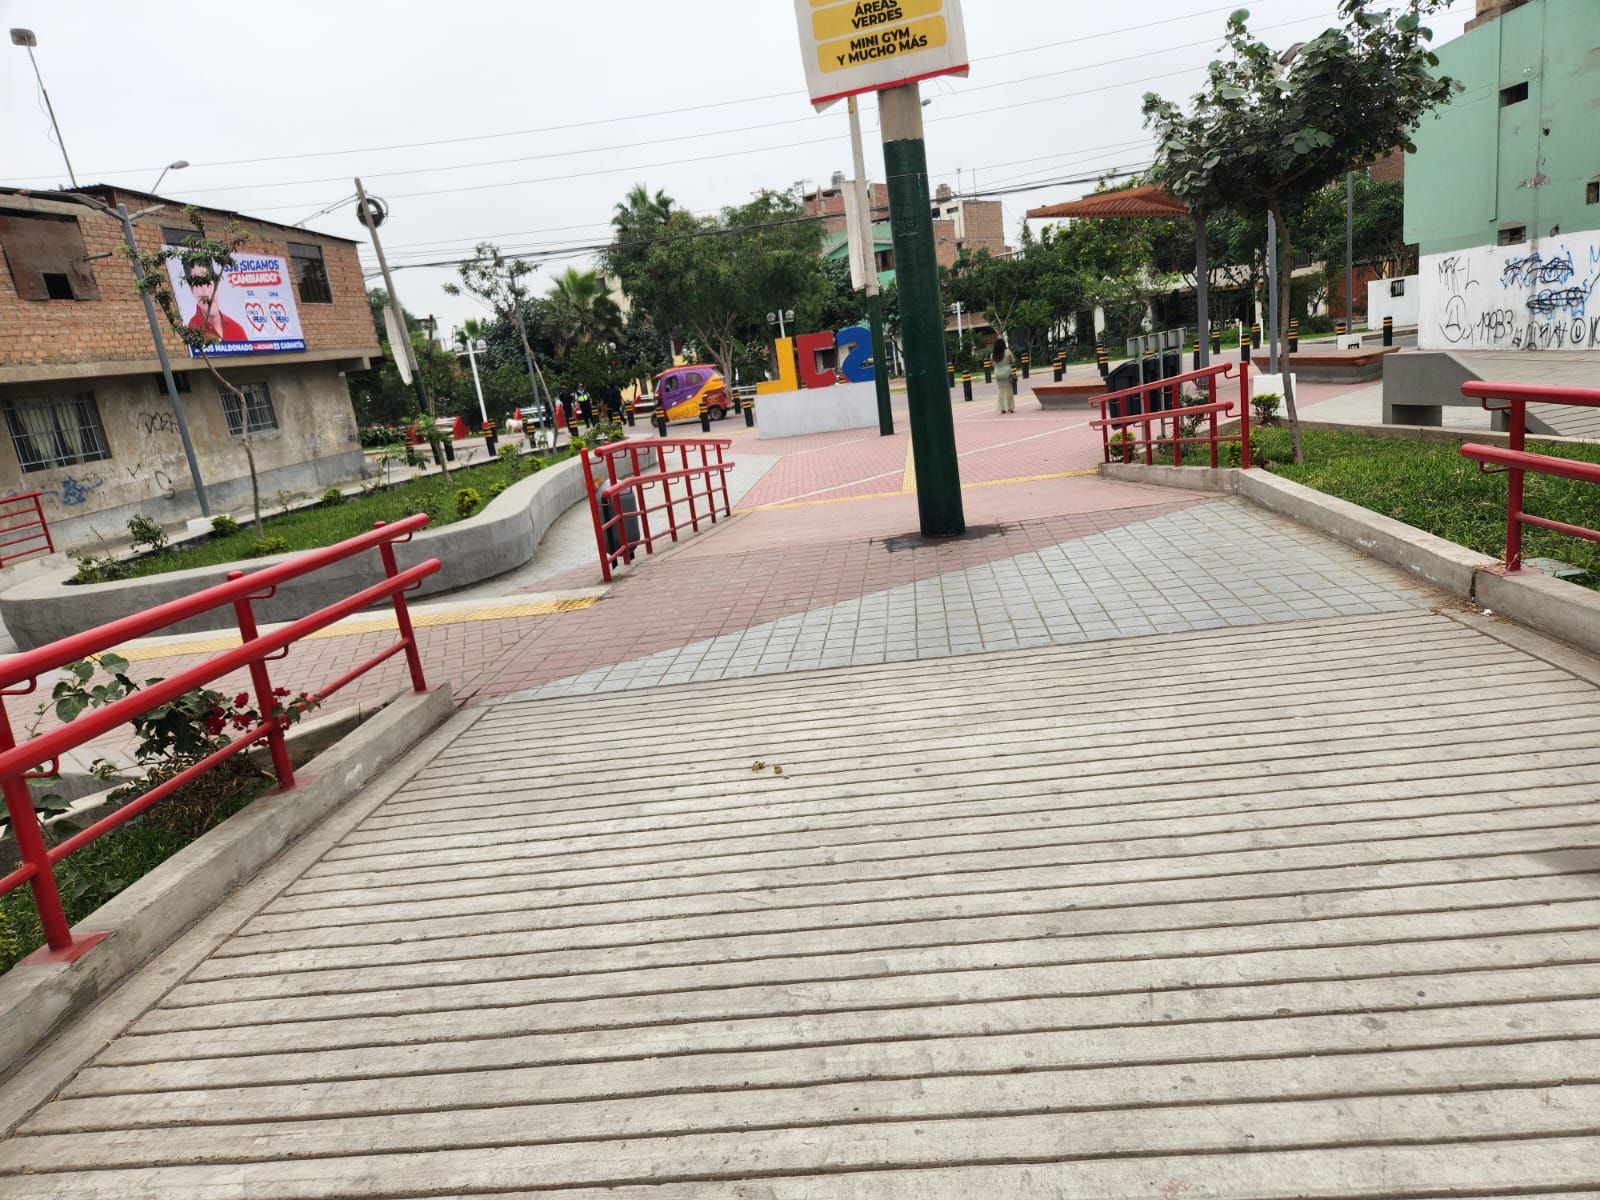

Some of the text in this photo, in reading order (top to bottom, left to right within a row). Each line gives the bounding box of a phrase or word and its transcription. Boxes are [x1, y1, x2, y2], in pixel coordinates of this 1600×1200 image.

[851, 8, 903, 29] VERDES
[854, 0, 898, 17] ÁREAS
[850, 27, 910, 51] MINI GYM
[836, 34, 928, 66] Y MUCHO MÁS
[214, 342, 253, 353] MALDONADO
